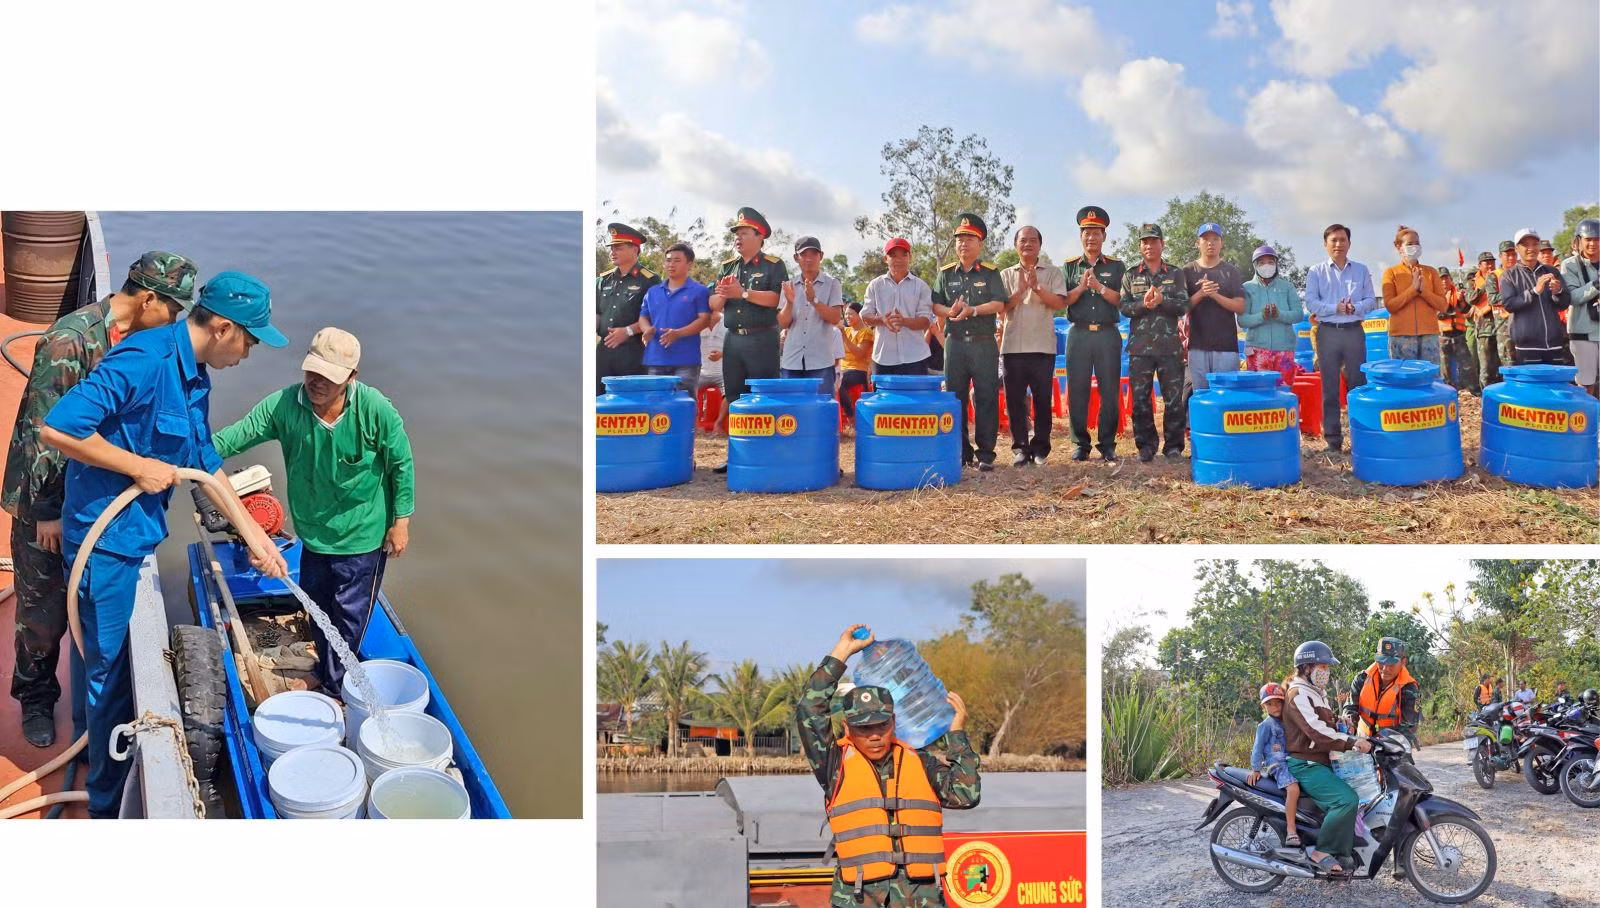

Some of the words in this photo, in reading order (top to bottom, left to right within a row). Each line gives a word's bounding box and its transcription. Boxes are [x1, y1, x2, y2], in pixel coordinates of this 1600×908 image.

[596, 415, 647, 429] IENTAY
[655, 416, 668, 427] 10
[877, 415, 937, 429] MIENTAY
[943, 415, 952, 426] 10
[1227, 410, 1286, 426] MIENTAY
[1383, 406, 1444, 425] MIENTAY
[1501, 405, 1566, 426] MIENTAY
[1574, 415, 1584, 426] 10
[781, 418, 794, 429] 10
[1017, 881, 1057, 905] CHUNG
[1060, 875, 1083, 904] SỨC
